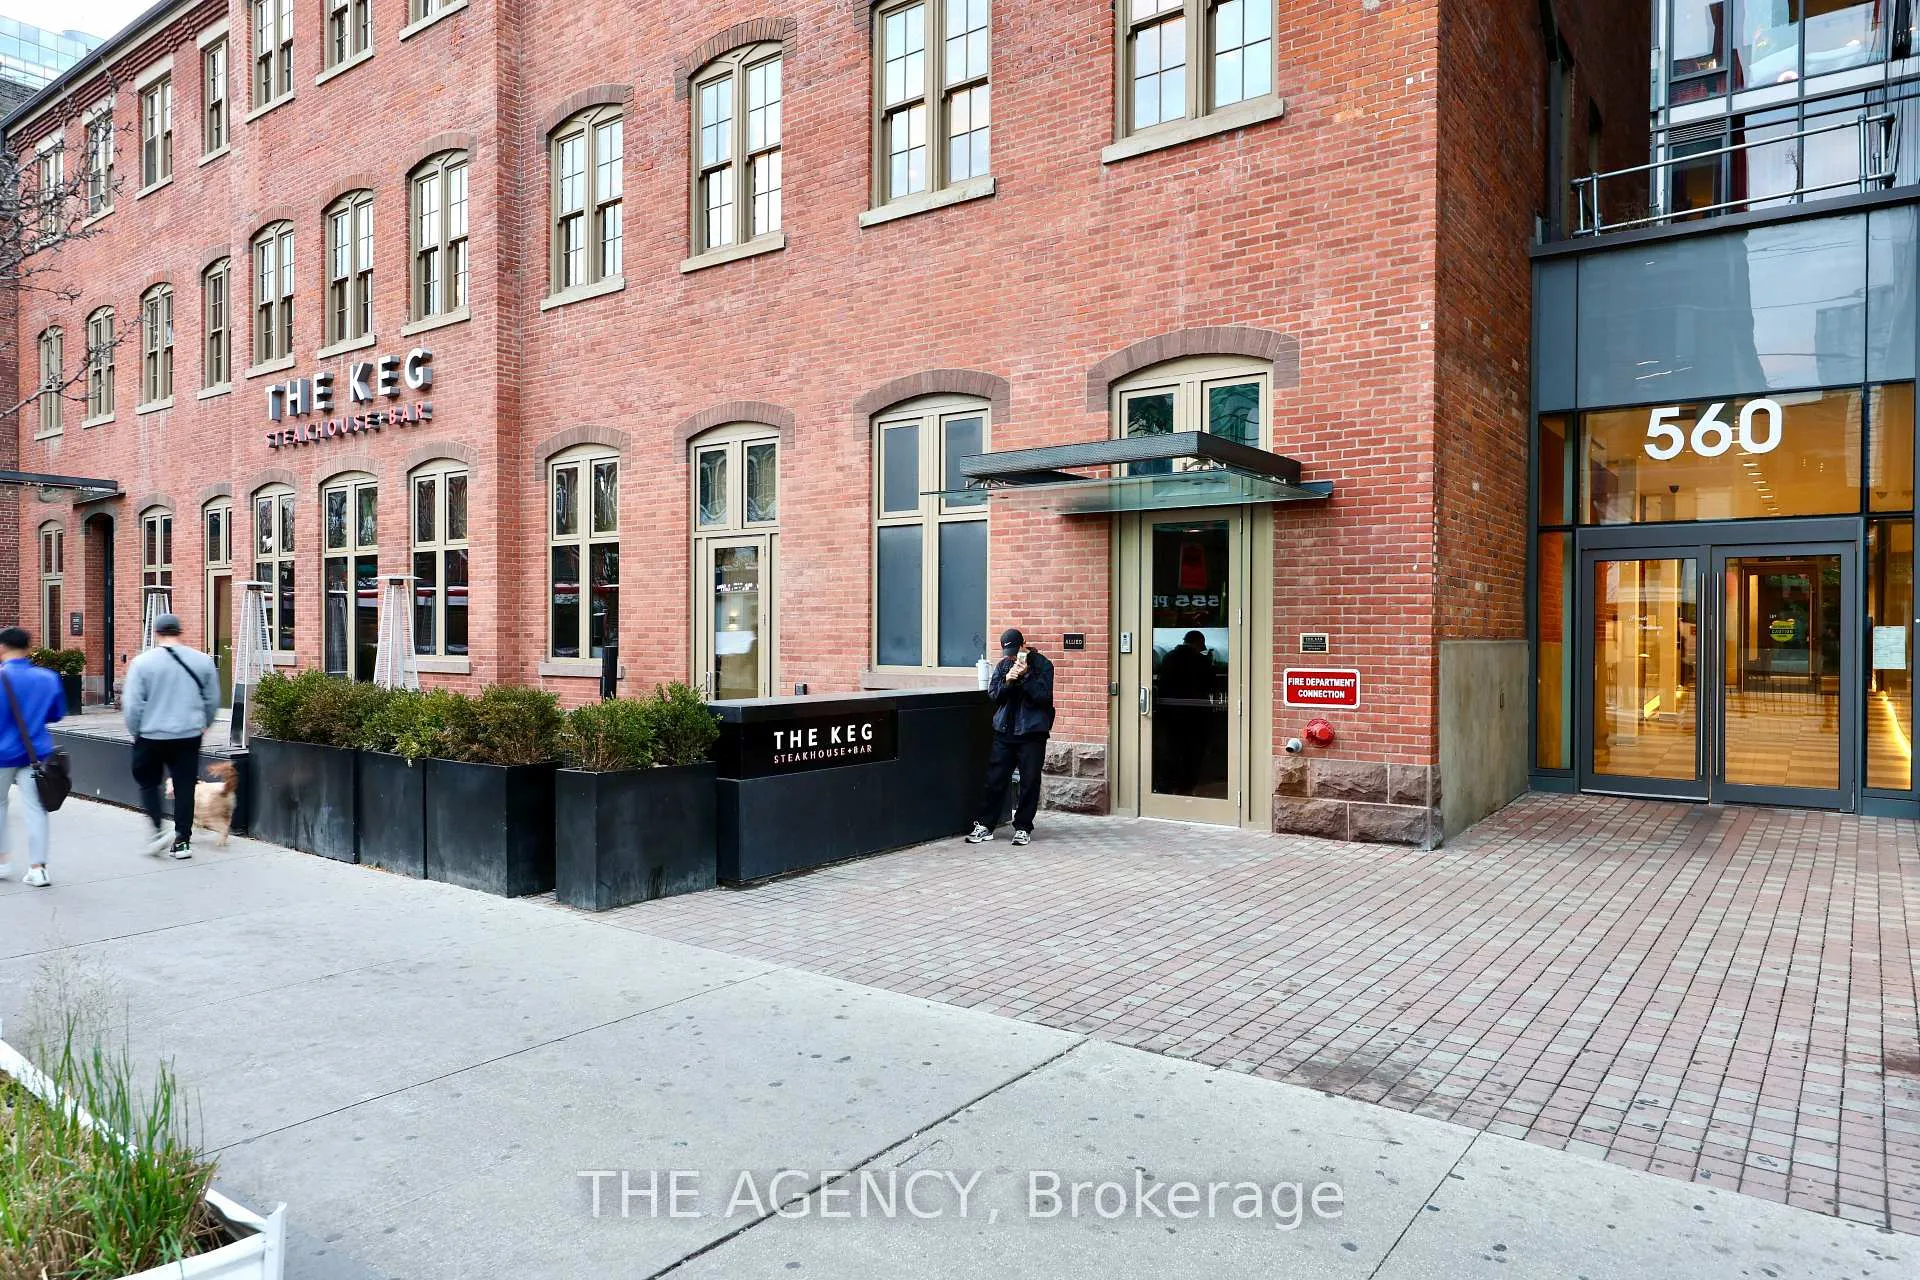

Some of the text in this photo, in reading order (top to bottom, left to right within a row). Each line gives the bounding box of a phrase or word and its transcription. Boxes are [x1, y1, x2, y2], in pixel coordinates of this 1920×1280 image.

[265, 347, 432, 421] THE KEG
[1643, 398, 1783, 461] 560
[1288, 677, 1356, 687] FIRE DEPARTMENT
[1298, 690, 1345, 698] CONNECTION
[773, 723, 873, 750] THE KEG
